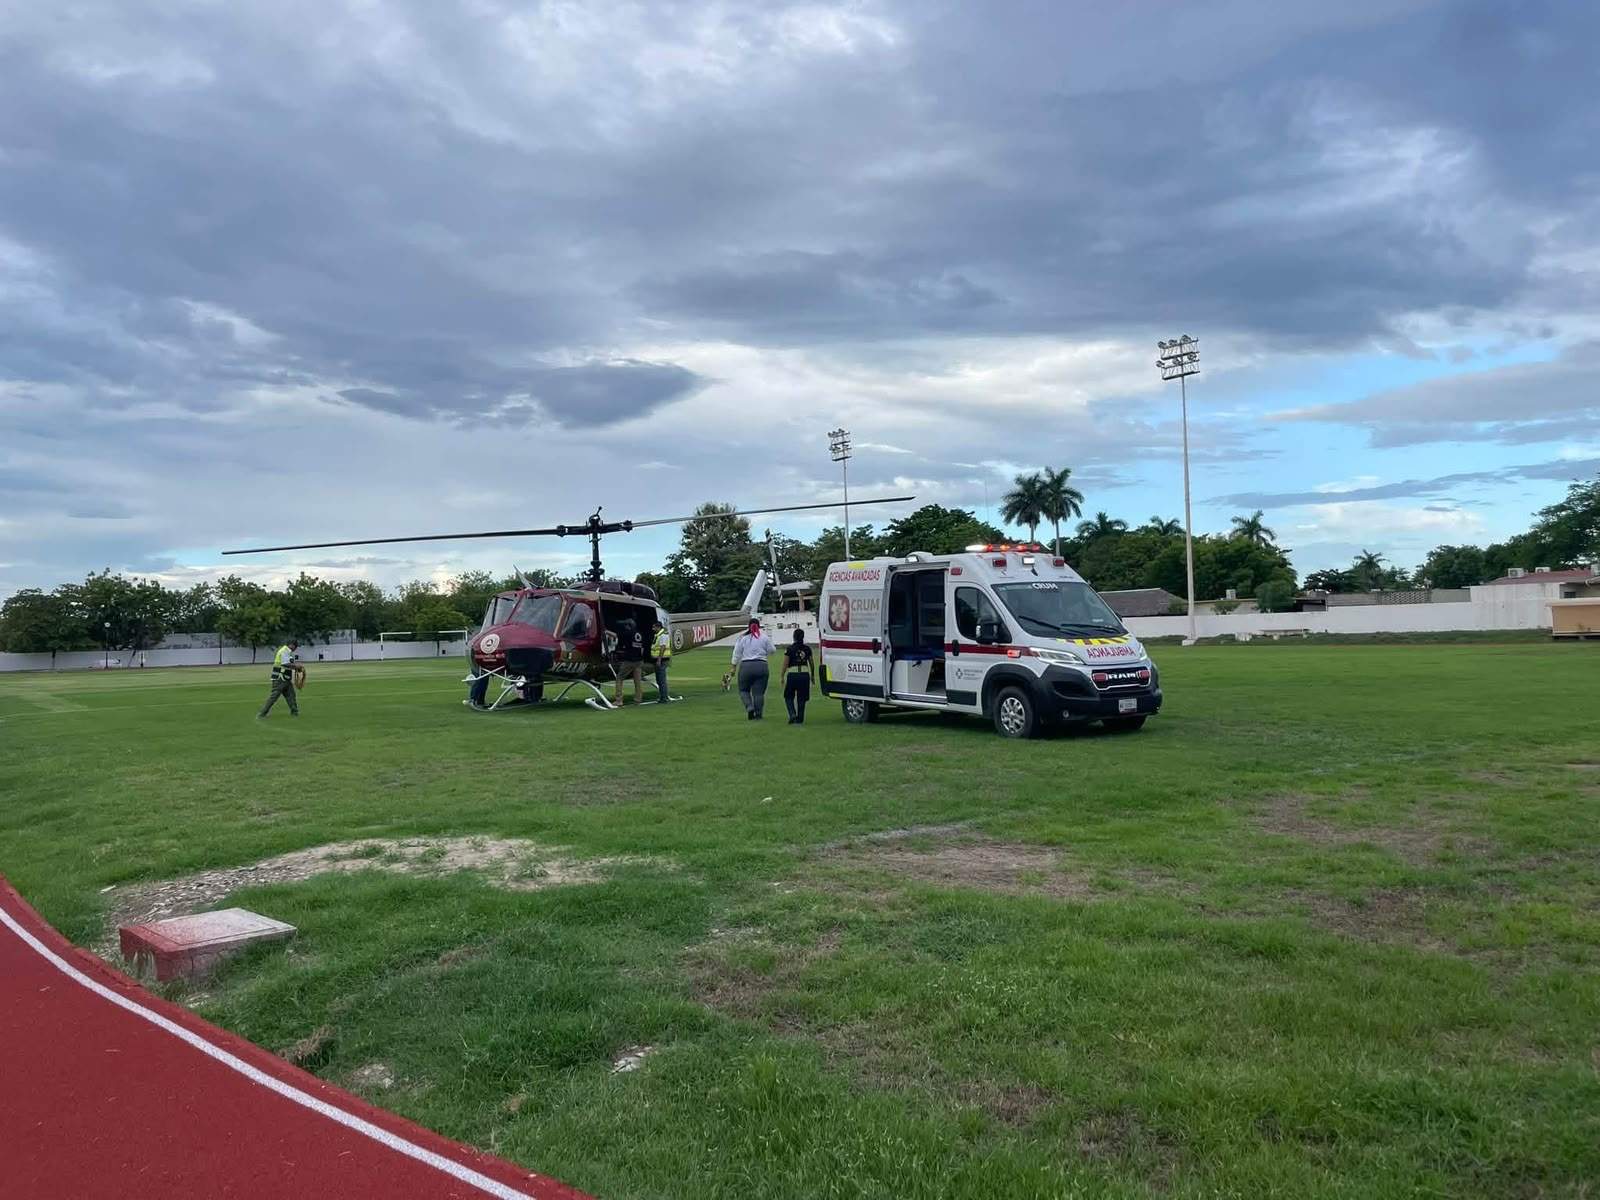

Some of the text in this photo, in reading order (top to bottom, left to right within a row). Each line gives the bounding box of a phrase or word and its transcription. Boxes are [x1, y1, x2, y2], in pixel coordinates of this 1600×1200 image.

[850, 599, 880, 611] CRUM
[847, 662, 873, 674] SALUD
[1108, 672, 1137, 680] RAM
